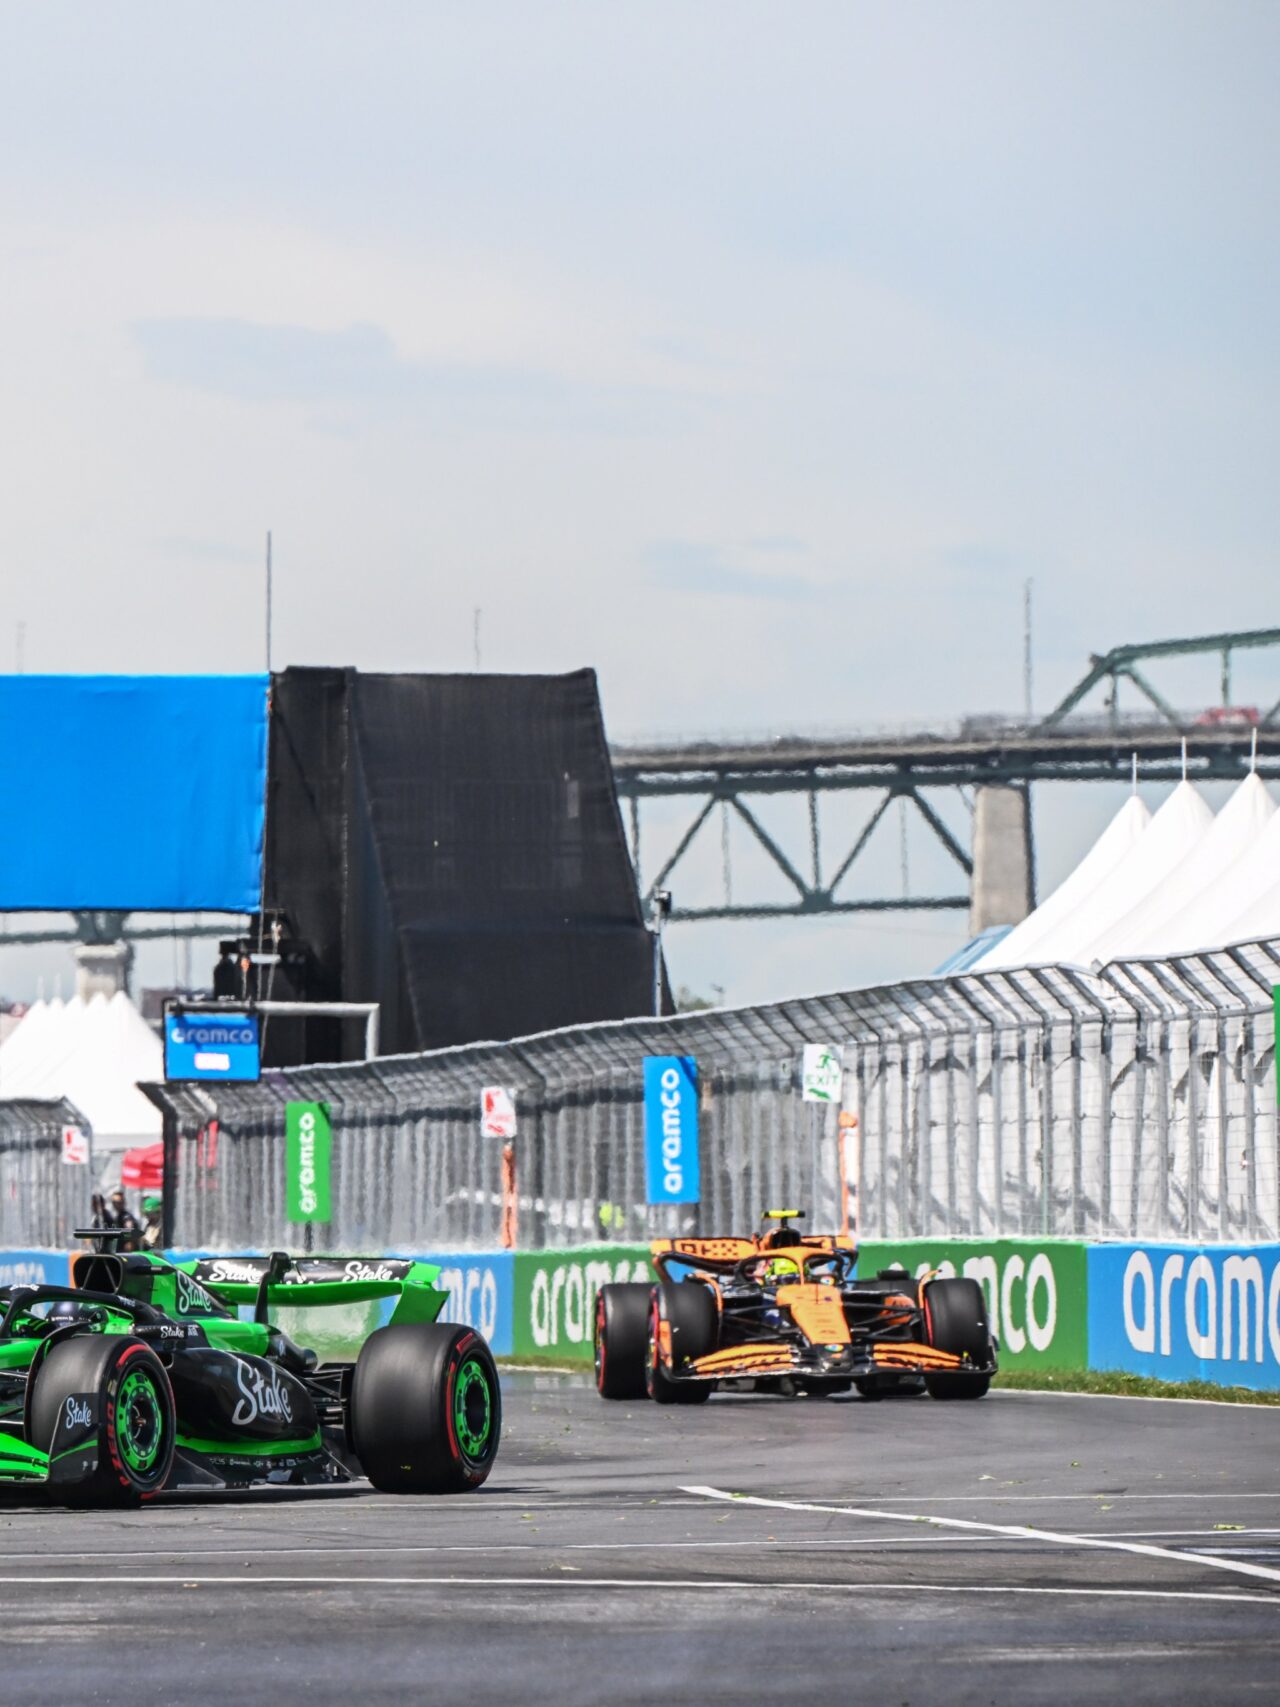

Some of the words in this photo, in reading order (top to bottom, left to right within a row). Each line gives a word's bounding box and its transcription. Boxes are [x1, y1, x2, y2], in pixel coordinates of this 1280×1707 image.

[171, 1028, 254, 1044] aramco
[806, 1074, 839, 1085] EXIT
[662, 1068, 681, 1195] aramco
[299, 1112, 316, 1214] aramco
[209, 1260, 263, 1283] Stake
[343, 1260, 393, 1282] Stake
[177, 1269, 212, 1313] Stake
[160, 1326, 185, 1339] Stake
[231, 1358, 293, 1425] Stake
[65, 1397, 92, 1429] Stake
